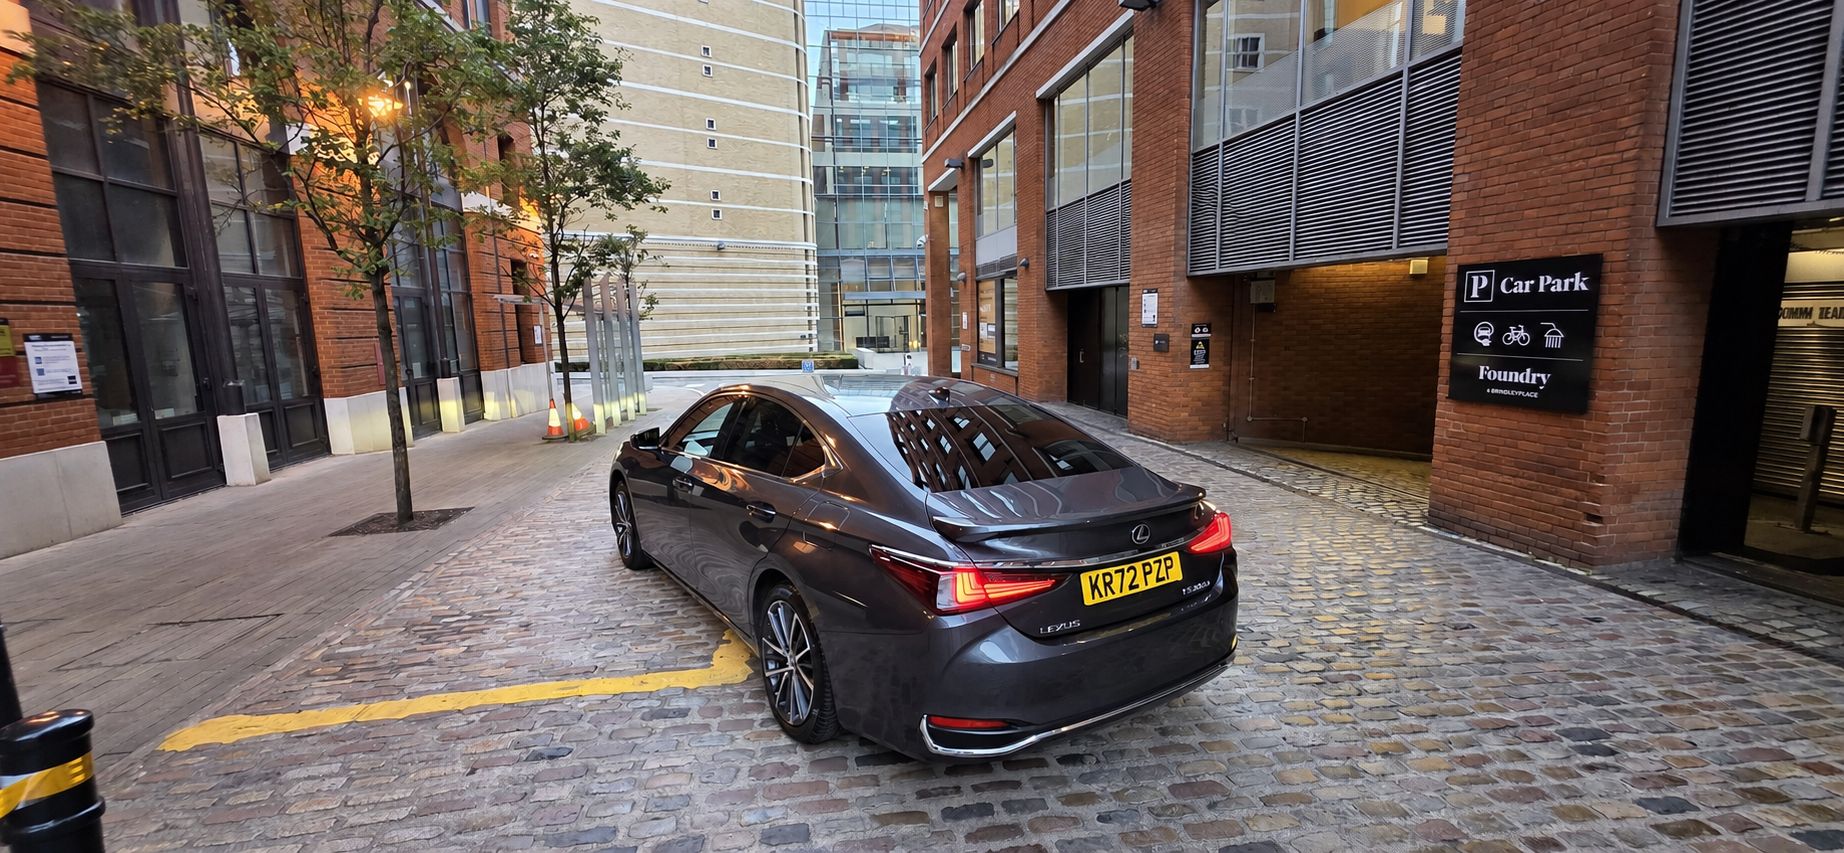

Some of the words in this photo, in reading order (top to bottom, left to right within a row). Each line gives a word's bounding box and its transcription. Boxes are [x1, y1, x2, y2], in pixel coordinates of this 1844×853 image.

[1470, 275, 1488, 298] P
[1500, 277, 1535, 294] Car
[1538, 271, 1590, 293] Park
[1478, 365, 1551, 390] Foundry
[1491, 388, 1539, 399] BRINDLEYPLACE
[1088, 565, 1140, 601] KR72
[1141, 556, 1174, 586] PZP
[1039, 619, 1081, 634] LEXUS
